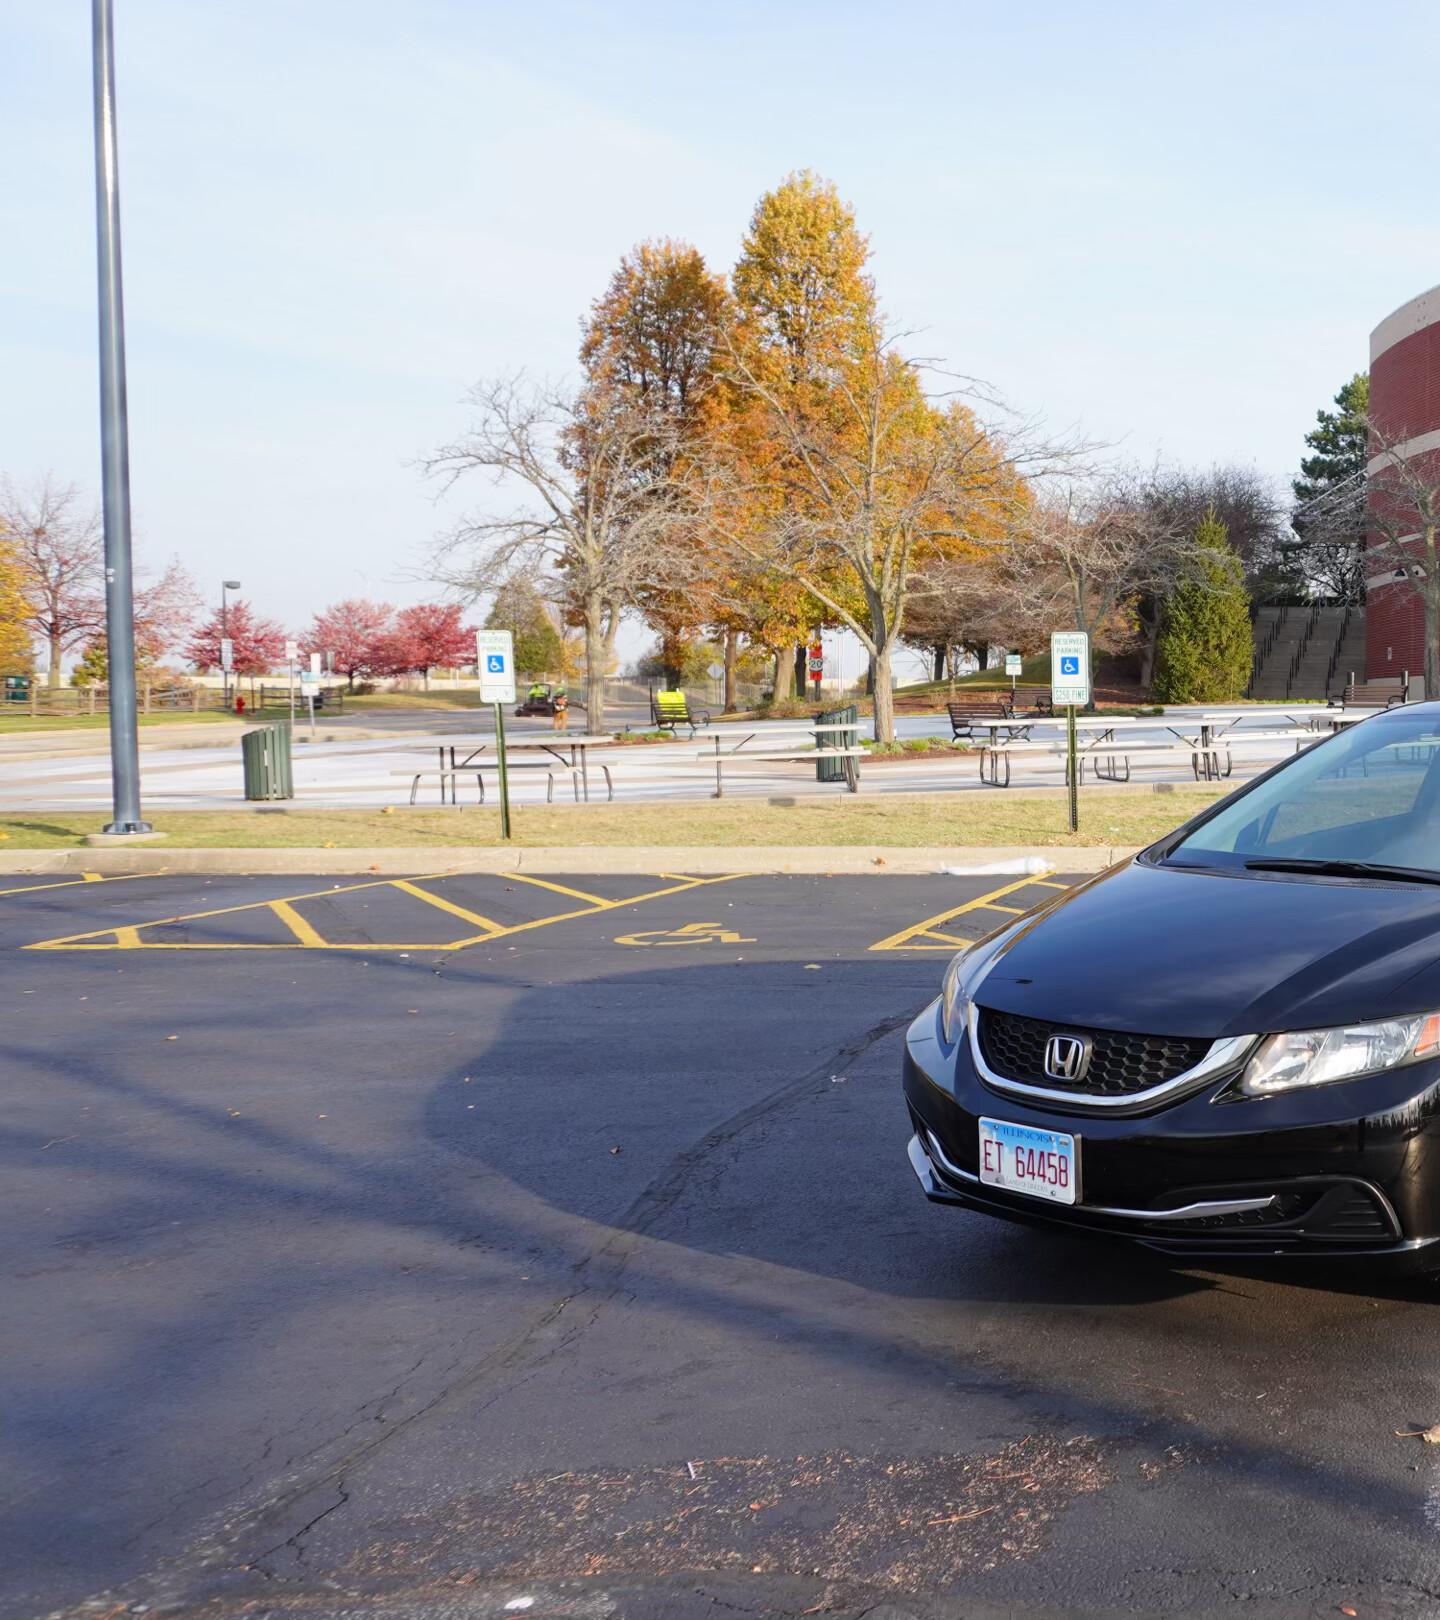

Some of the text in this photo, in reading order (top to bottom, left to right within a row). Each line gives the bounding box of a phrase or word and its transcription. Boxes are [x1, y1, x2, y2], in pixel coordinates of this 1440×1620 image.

[1072, 689, 1086, 700] FINE
[1003, 1127, 1050, 1143] ILLINOIS
[983, 1139, 1069, 1188] ET 64458
